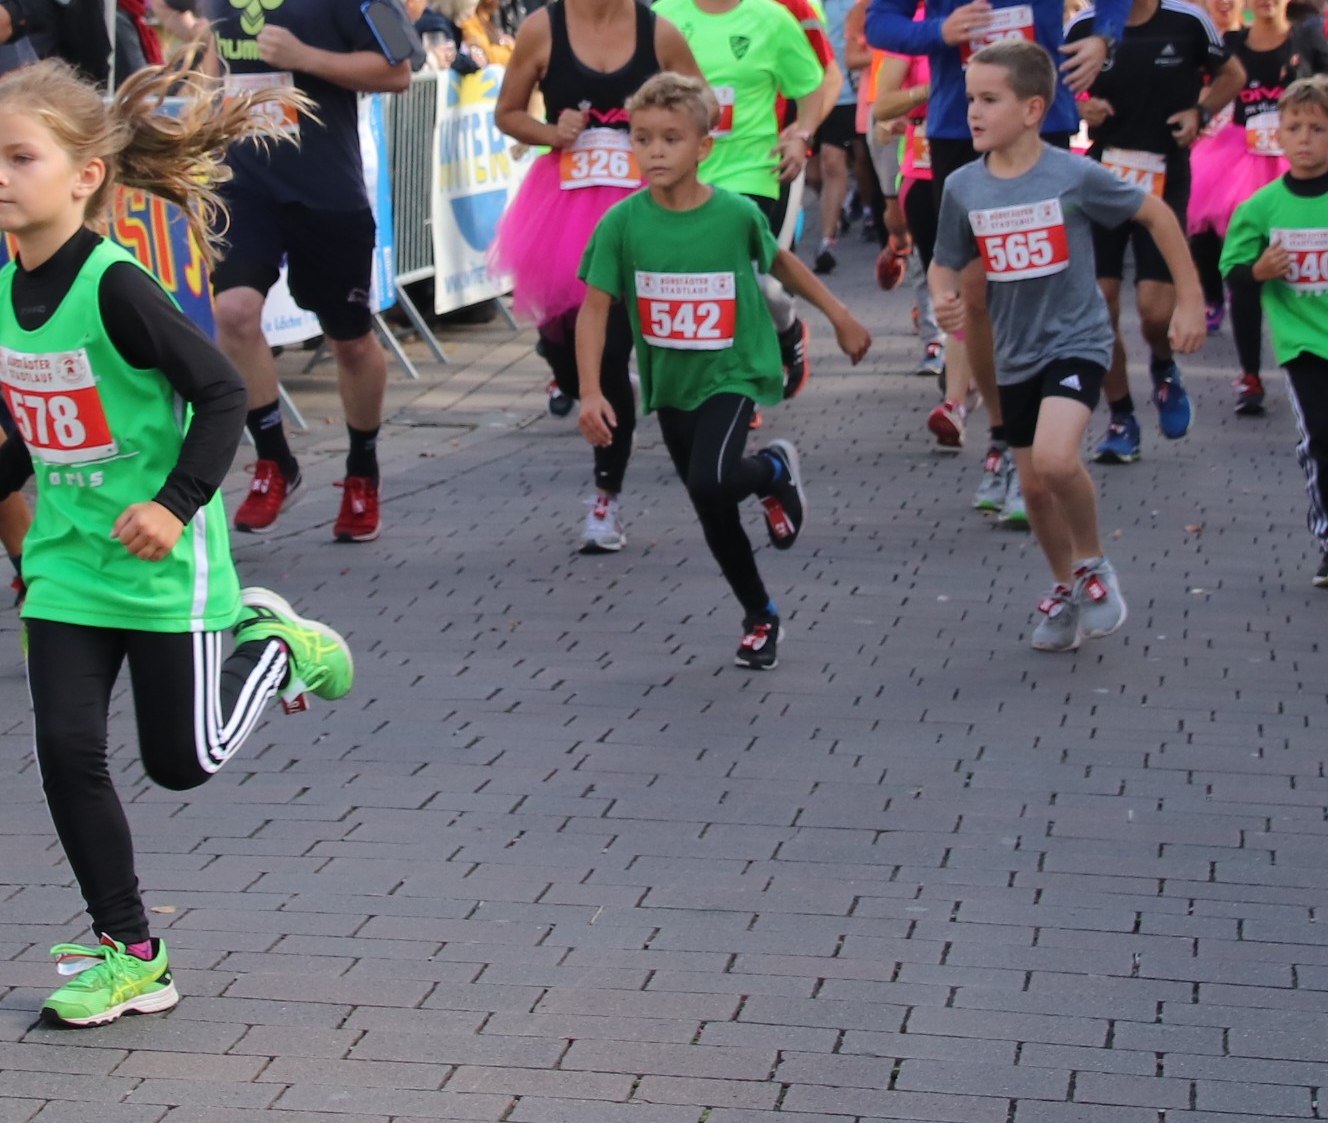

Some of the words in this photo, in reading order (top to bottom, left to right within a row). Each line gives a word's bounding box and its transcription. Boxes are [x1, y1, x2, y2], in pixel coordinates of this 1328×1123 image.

[571, 149, 630, 178] 326
[985, 230, 1053, 272] 565
[650, 302, 721, 339] 542
[9, 390, 87, 448] 578
